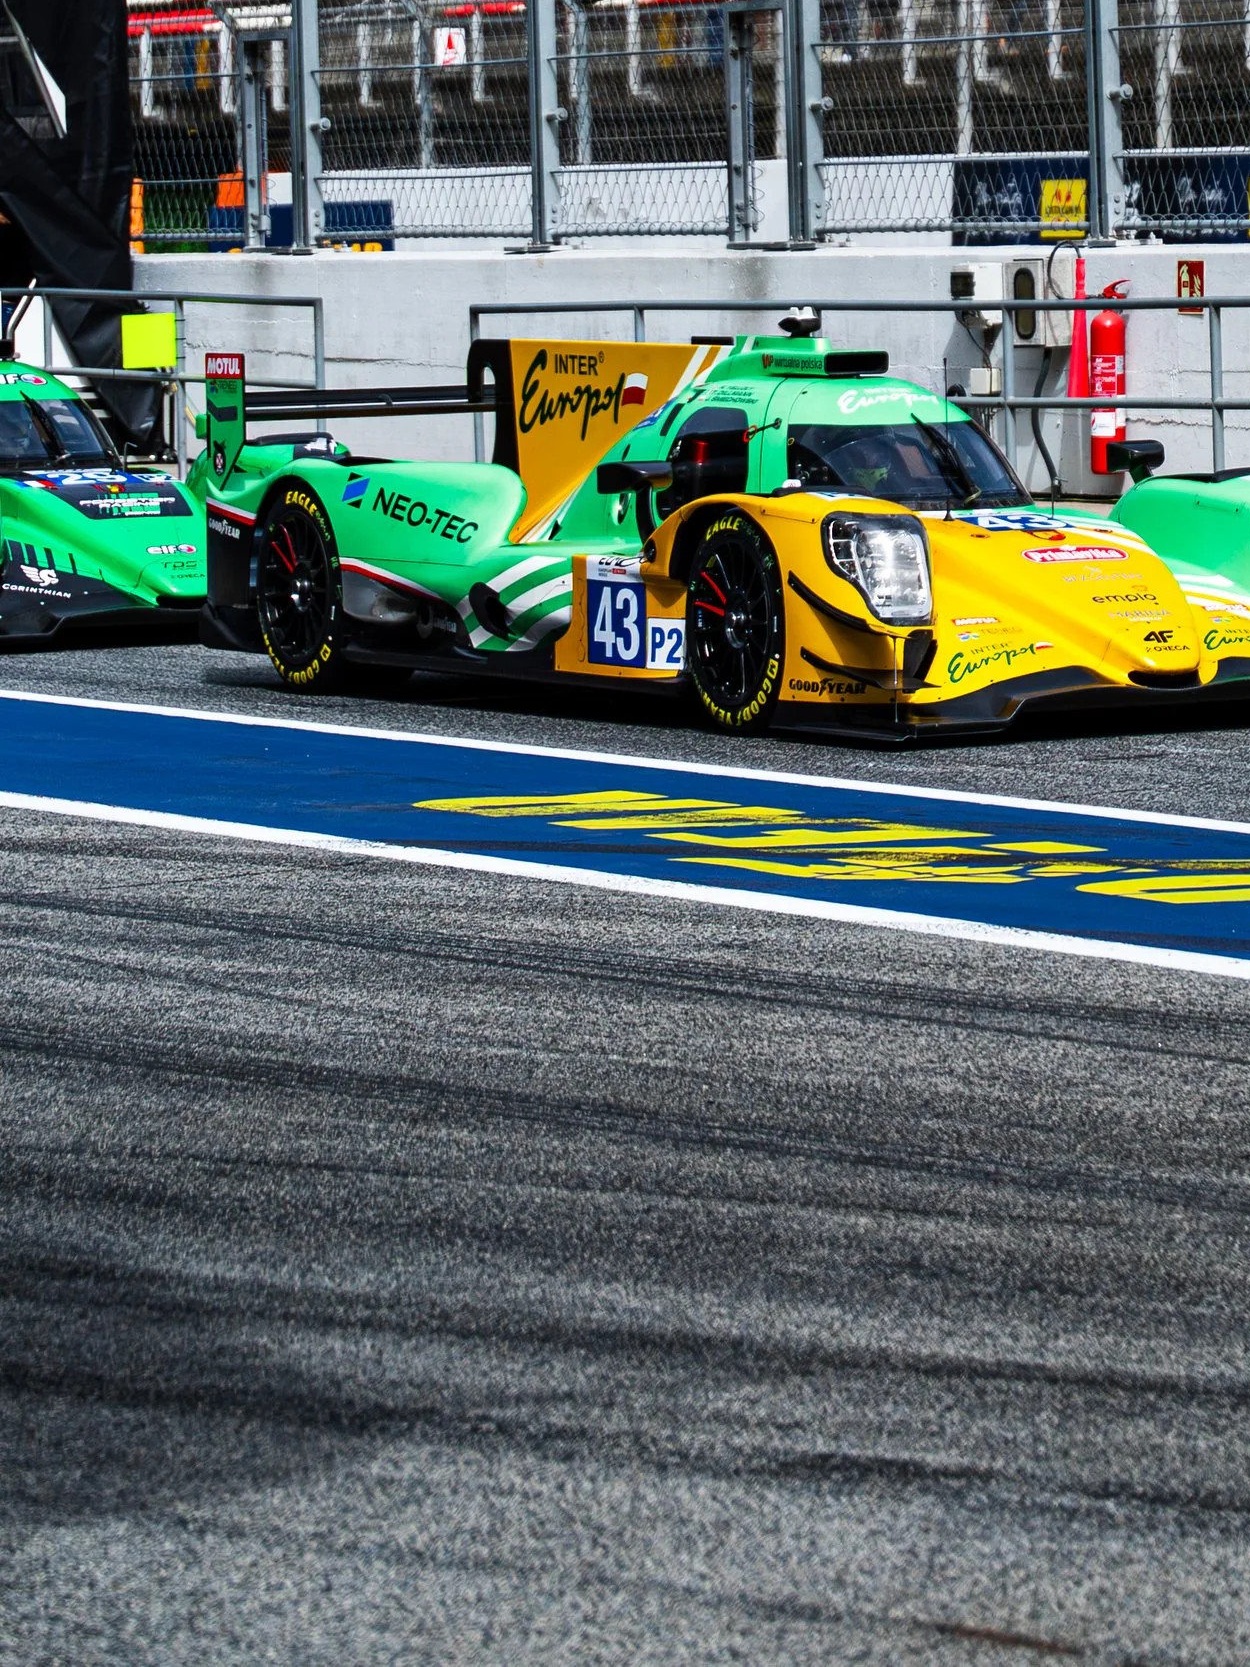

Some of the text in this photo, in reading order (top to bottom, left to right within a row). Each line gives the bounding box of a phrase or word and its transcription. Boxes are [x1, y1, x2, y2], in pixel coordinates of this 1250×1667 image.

[207, 357, 240, 375] MOTUL
[554, 353, 599, 376] INTER
[801, 357, 823, 370] polska
[519, 349, 626, 441] Europol
[285, 490, 319, 517] EAGLE
[372, 487, 479, 544] NEO-TEC
[976, 514, 1066, 531] 43
[208, 518, 241, 540] GOODYEAR
[705, 515, 742, 542] EAGLE
[1030, 546, 1123, 562] Primavika
[2, 583, 72, 599] CORINTHIAN
[594, 586, 640, 661] 43
[650, 626, 684, 664] P2
[1143, 629, 1174, 643] 4F
[970, 643, 1009, 656] INTER
[1154, 644, 1190, 653] ORECA
[947, 643, 1036, 684] Europol
[788, 678, 866, 696] GOODYEAR
[699, 678, 774, 727] GOODYEAR
